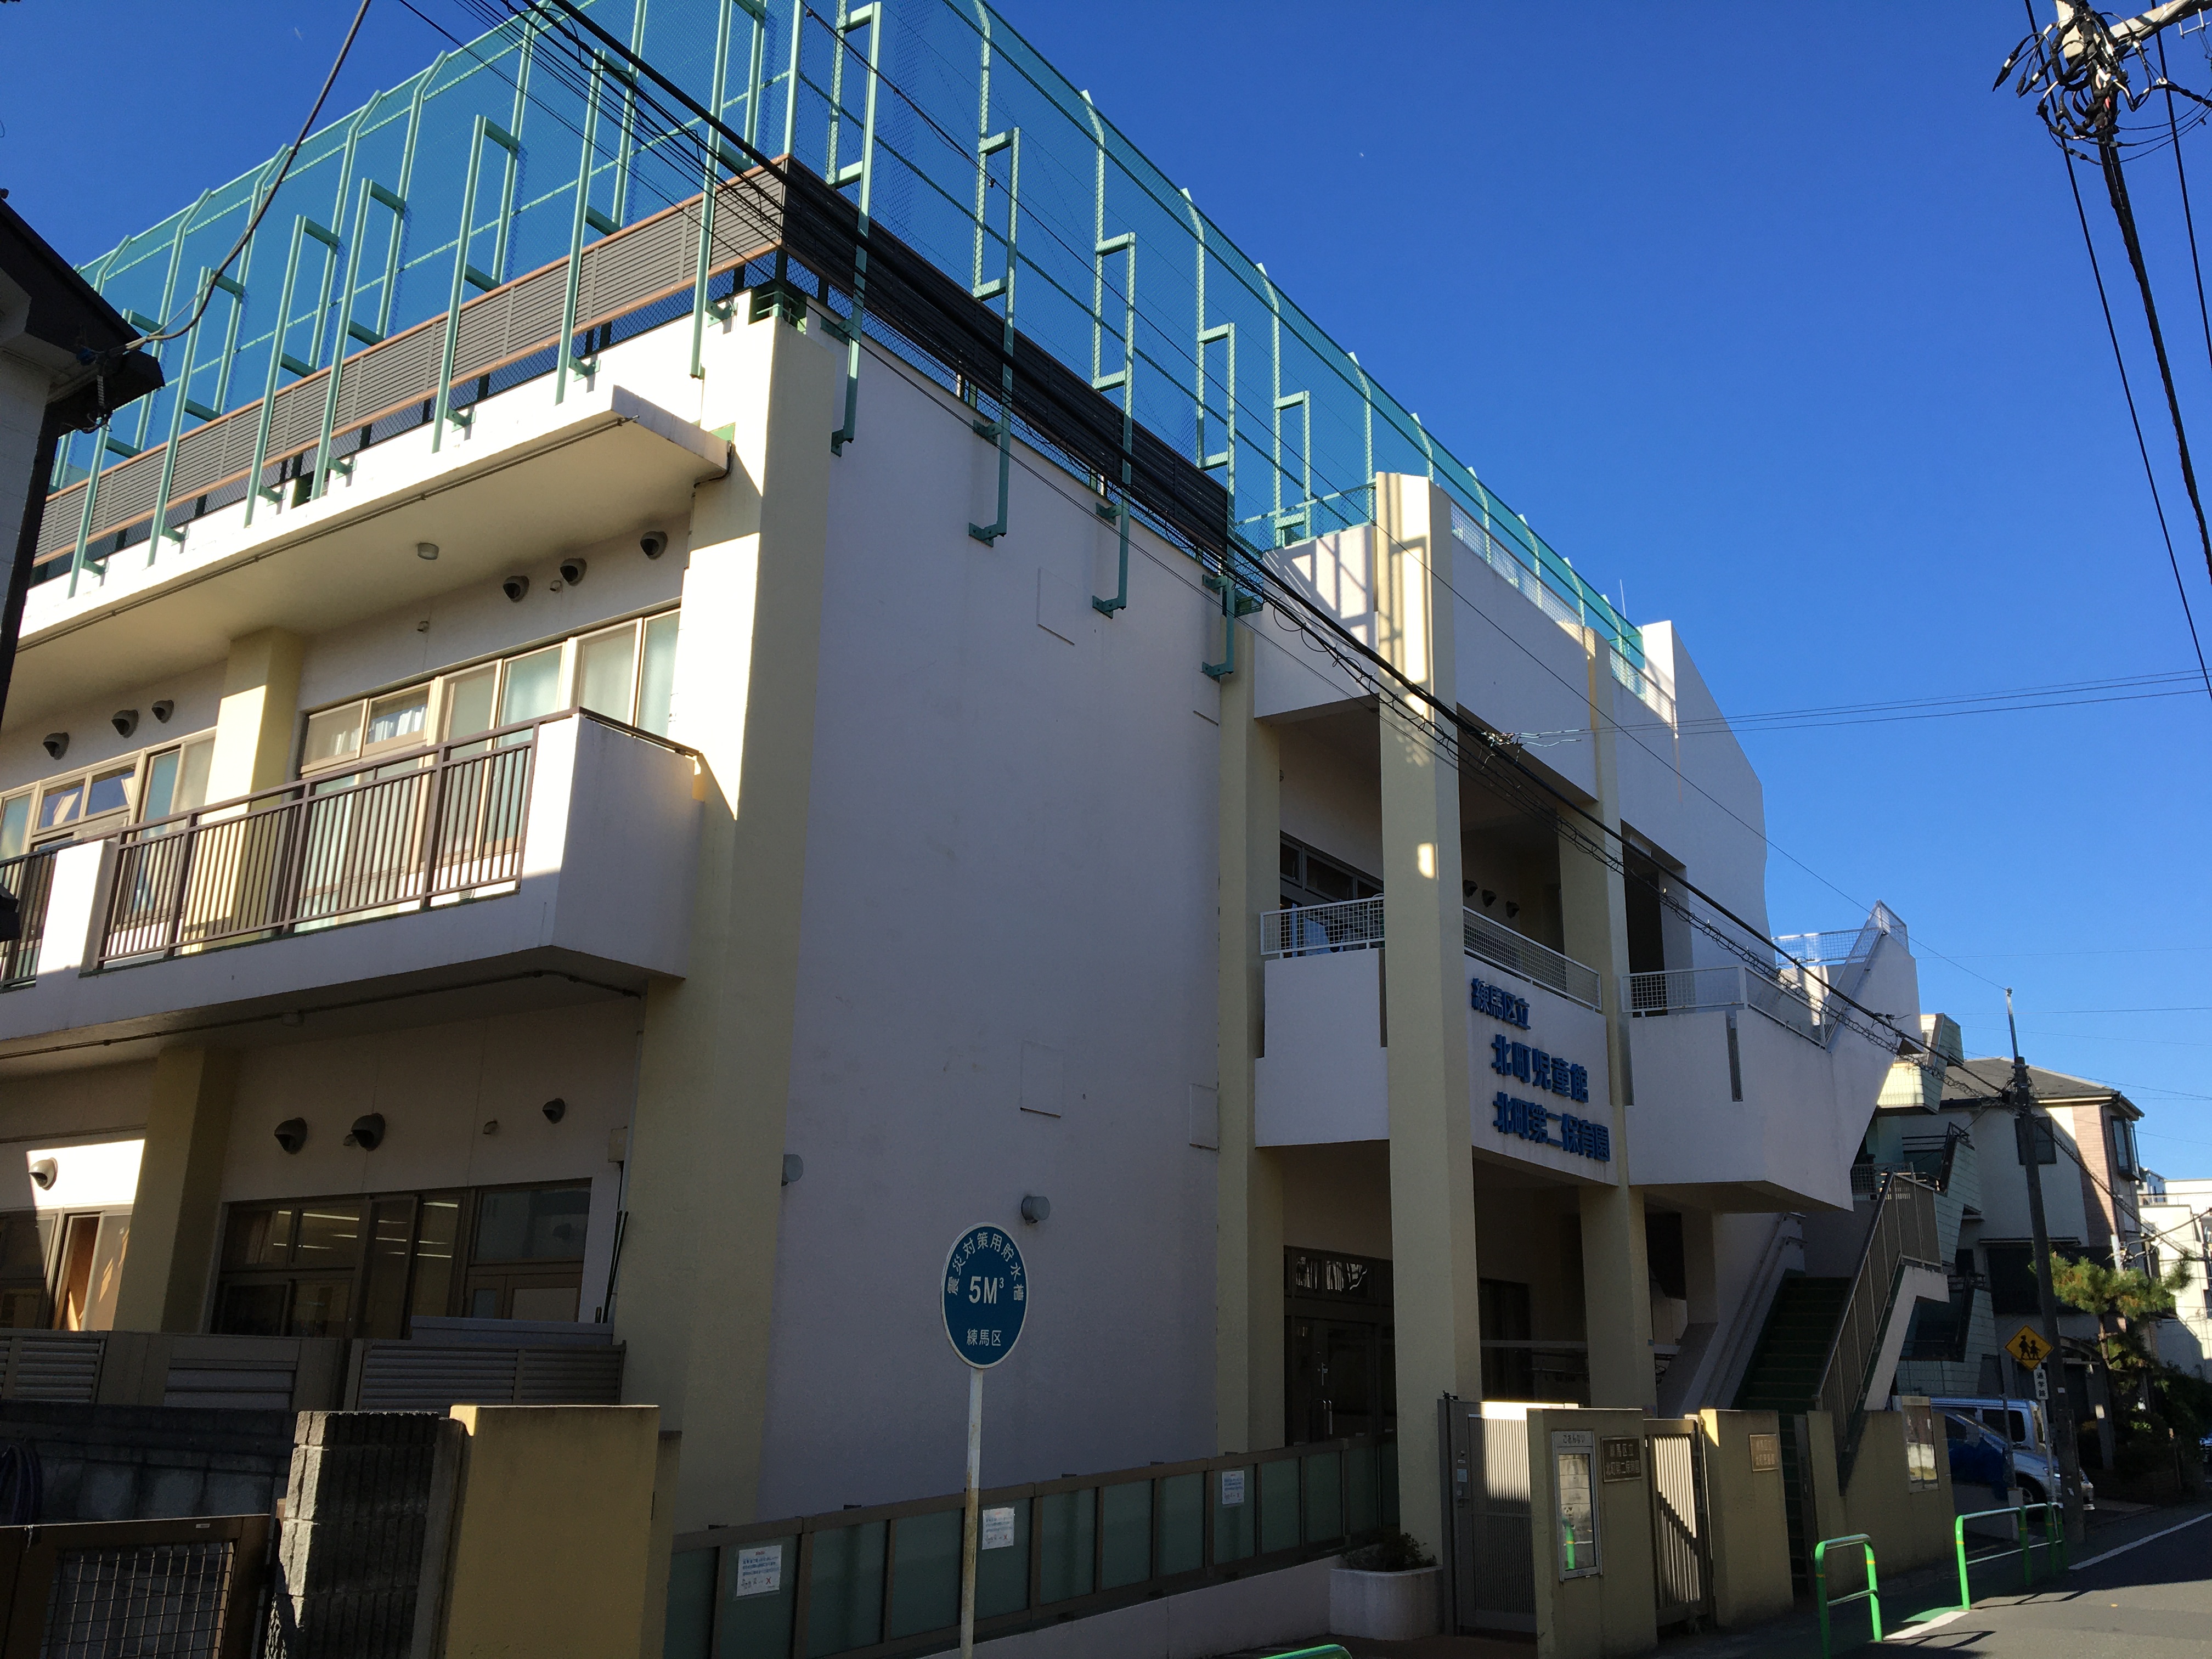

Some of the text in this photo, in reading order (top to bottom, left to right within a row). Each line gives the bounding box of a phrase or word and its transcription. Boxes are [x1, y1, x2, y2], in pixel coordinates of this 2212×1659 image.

[1471, 978, 1531, 1030] 練馬区立
[1491, 1034, 1588, 1103] 北町児童館
[1493, 1091, 1610, 1162] 北町第二保育園
[947, 1232, 1024, 1301] 震災対策用貯水槽
[967, 1328, 1002, 1346] 練馬区
[2036, 1372, 2046, 1397] 通学路
